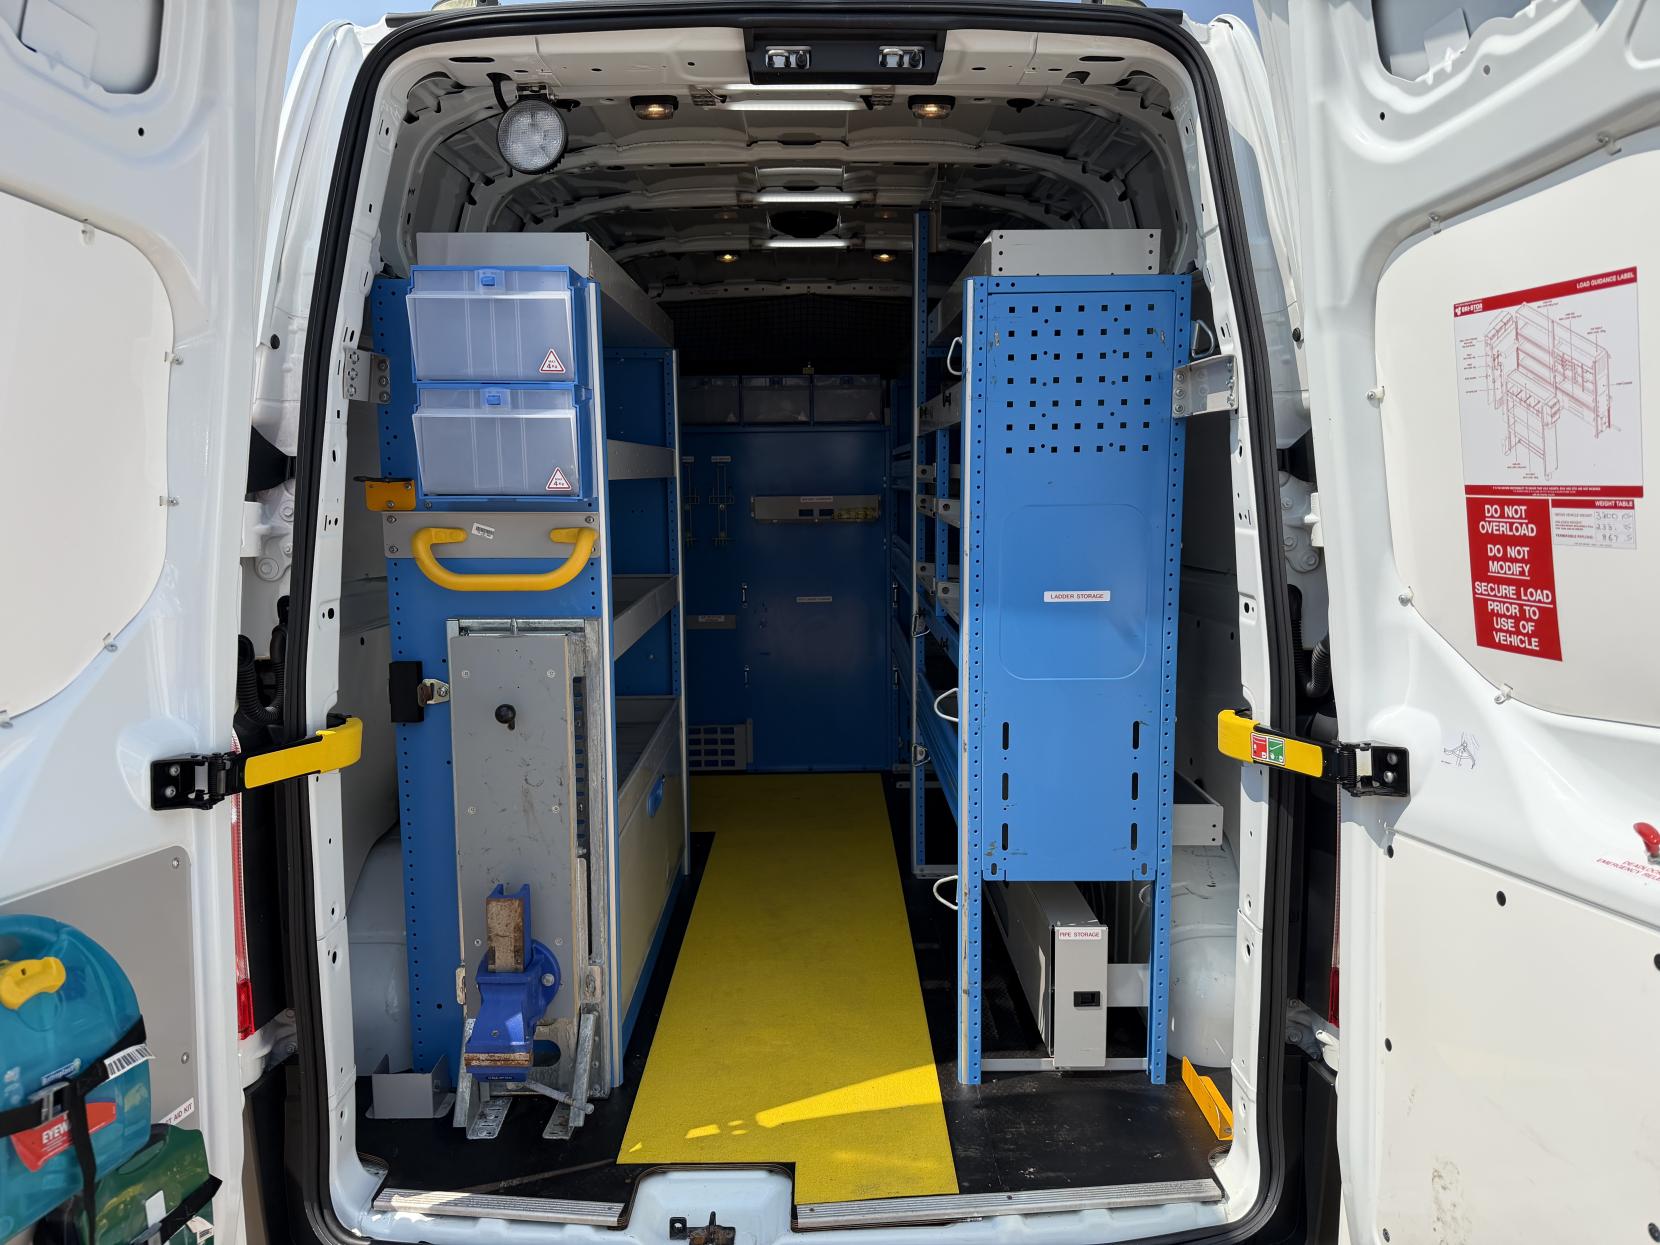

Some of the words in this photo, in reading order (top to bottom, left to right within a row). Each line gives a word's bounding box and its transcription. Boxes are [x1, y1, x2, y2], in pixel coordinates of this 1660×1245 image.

[1576, 280, 1591, 289] LOAD
[1590, 274, 1617, 287] GUIDANCE
[1616, 271, 1635, 281] LABEL
[1485, 504, 1501, 518] DO
[1504, 505, 1527, 519] NOT
[1479, 521, 1537, 537] OVERLOAD
[1487, 544, 1503, 558] DO
[1507, 545, 1530, 560] NOT
[1488, 560, 1530, 576] MODIFY
[1474, 581, 1517, 599] SECURE
[1520, 587, 1552, 603] LOAD
[1487, 601, 1520, 617] PRIOR
[1523, 606, 1539, 620] TO
[1493, 617, 1516, 631] USE
[1519, 621, 1535, 634] OF
[1493, 631, 1540, 650] VEHICLE
[174, 1111, 183, 1121] AID
[184, 1103, 193, 1113] KIT
